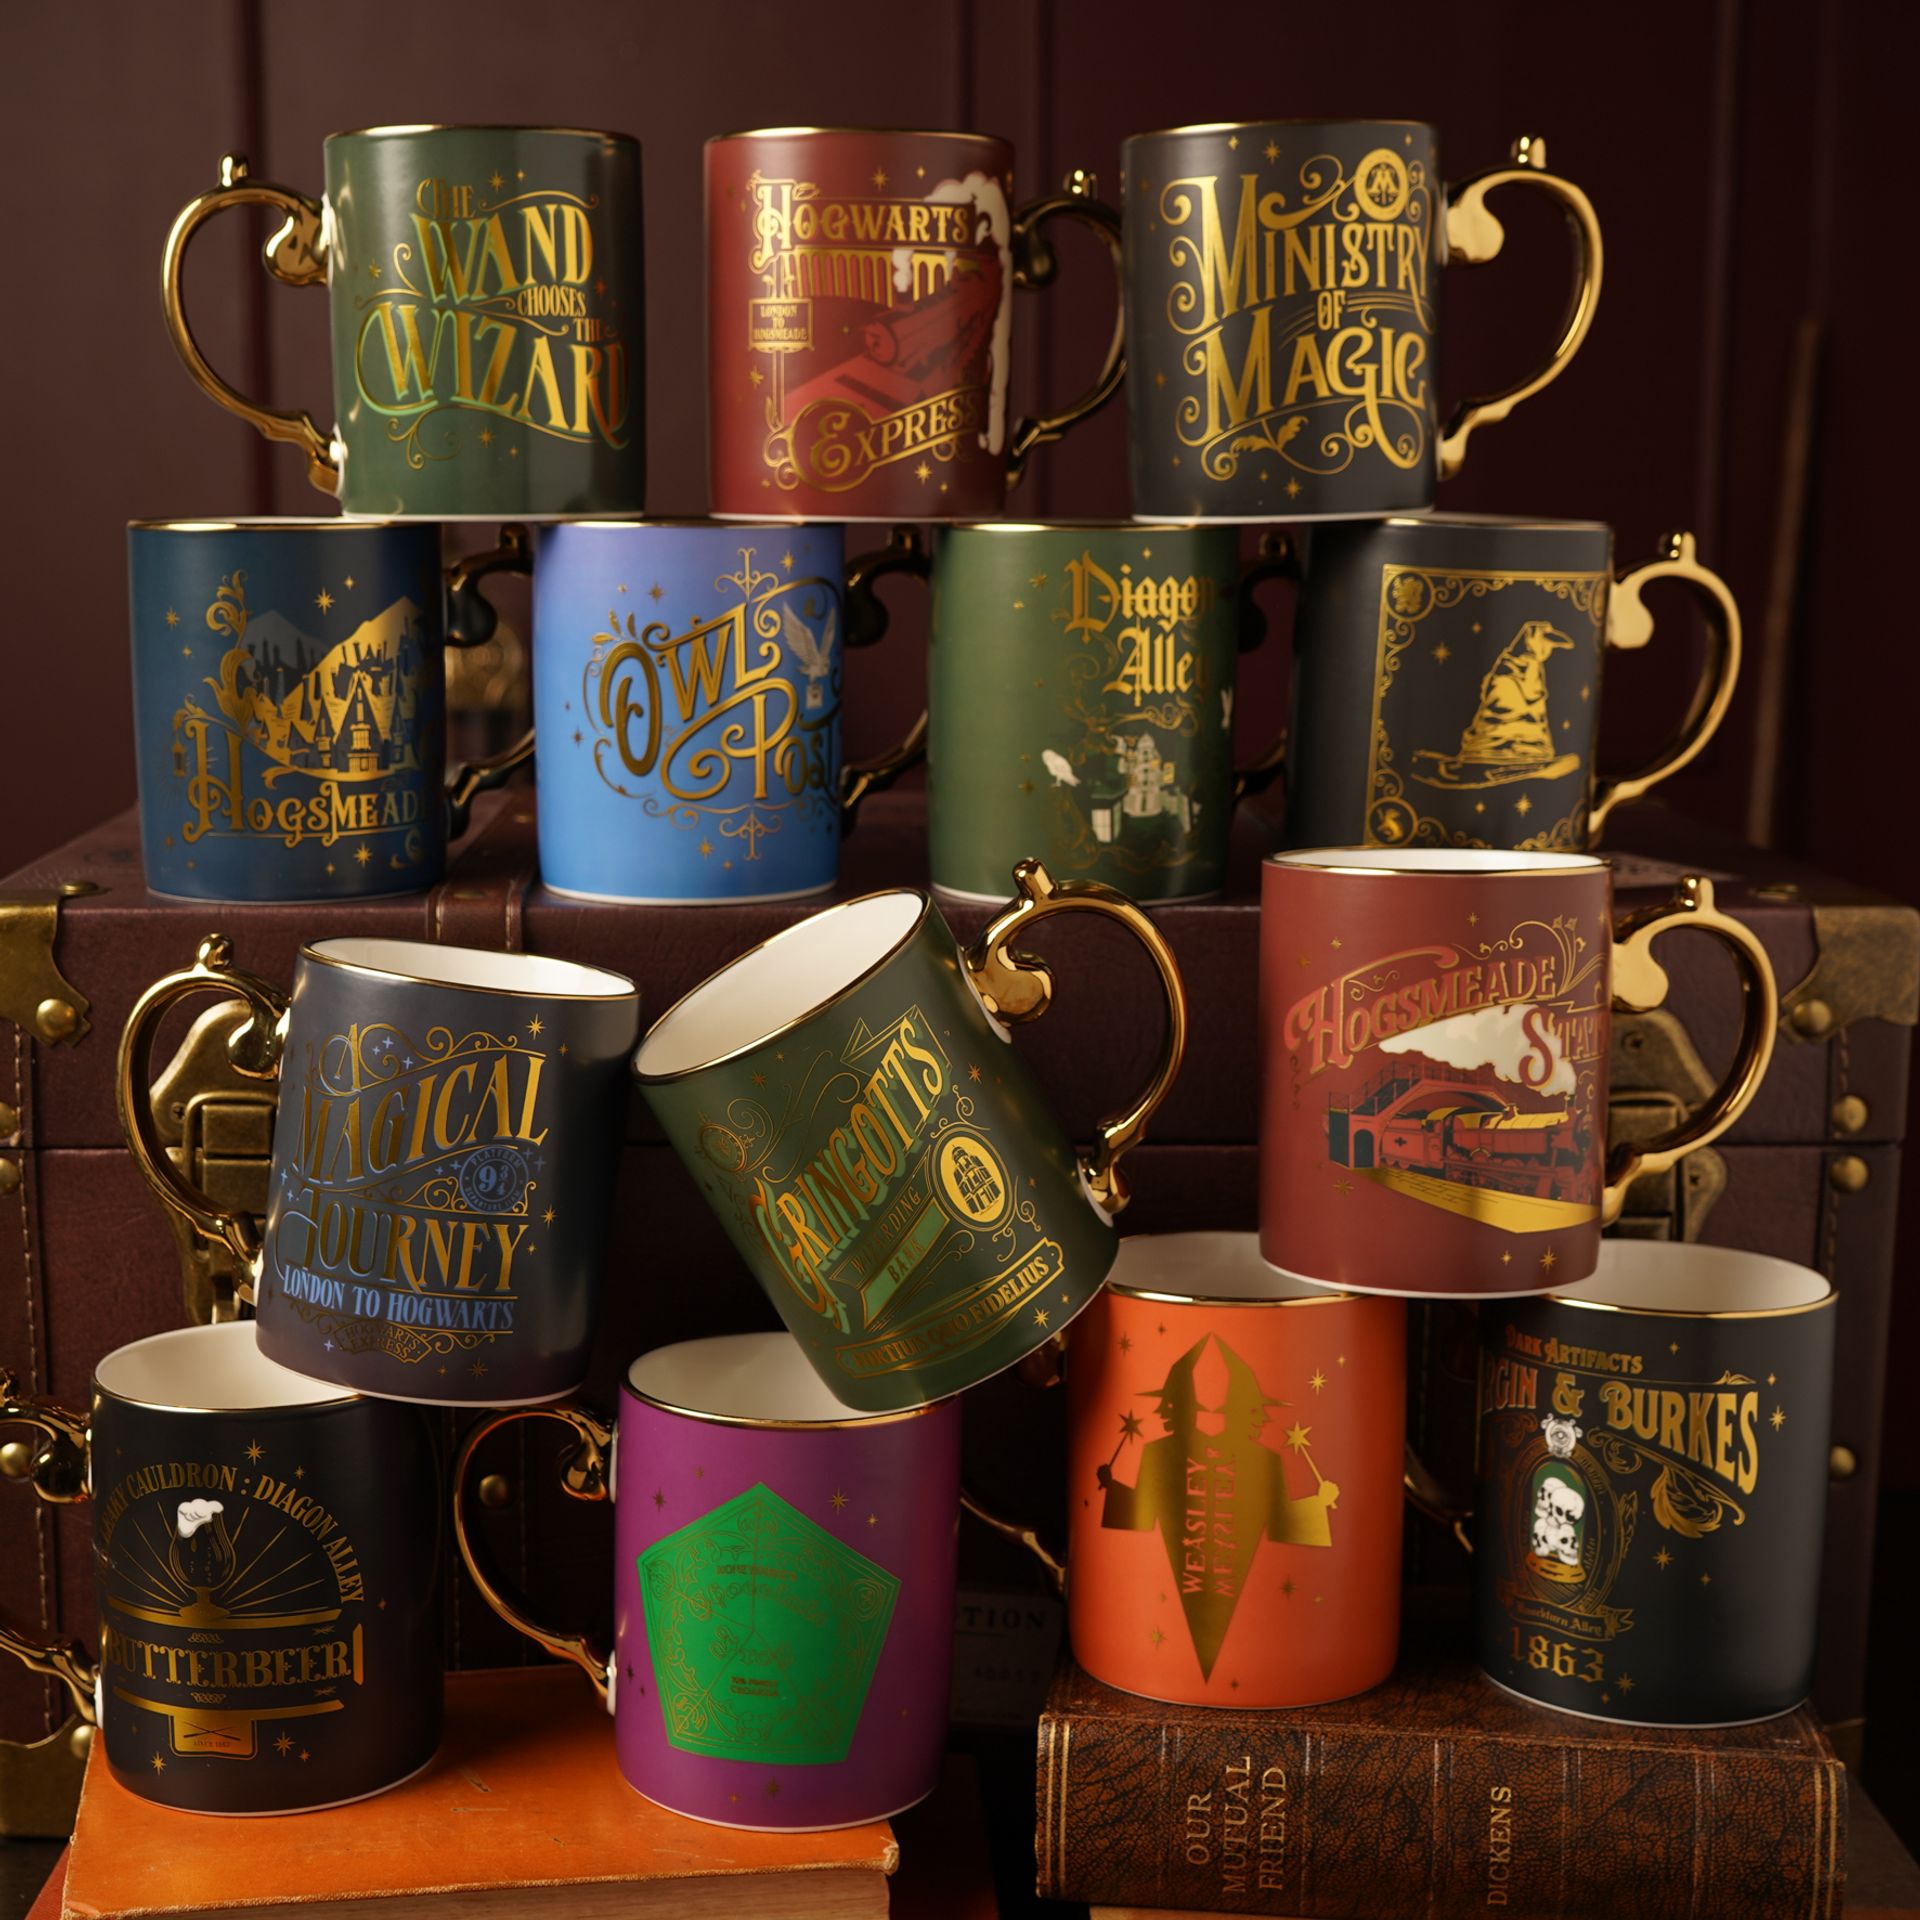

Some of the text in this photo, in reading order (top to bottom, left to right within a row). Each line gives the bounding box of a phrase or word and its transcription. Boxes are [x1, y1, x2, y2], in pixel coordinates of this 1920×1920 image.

[410, 203, 593, 306] WAND
[749, 170, 970, 273] HOGWARTS
[1160, 174, 1433, 335] MINISTRY
[517, 284, 587, 317] CHOOSES
[1316, 289, 1347, 331] OF
[354, 301, 631, 451] WIZARD
[809, 391, 979, 479] EXPRESS
[1173, 305, 1428, 469] MAGIC
[1283, 945, 1558, 1075] HOGSMEADE
[291, 1053, 549, 1184] MAGICAL
[750, 1016, 950, 1334] GRINGOTTS
[275, 1188, 529, 1294] JOURNEY
[283, 1264, 516, 1334] LONDON TO HOGWARTS
[966, 1254, 1051, 1324] FIDELIUS
[1543, 1336, 1644, 1376] ARTIFACTS
[1551, 1372, 1585, 1418] &
[1599, 1380, 1760, 1496] BURKES
[126, 1461, 238, 1500] CAULDRON
[253, 1474, 338, 1541] DIAGON
[322, 1535, 365, 1604] ALLEY
[1181, 1456, 1208, 1596] WEASLEY
[1185, 1790, 1213, 1865] OUR
[1221, 1754, 1251, 1894] MUTUAL
[1257, 1766, 1287, 1891] FRIEND
[1486, 1785, 1513, 1906] DICKENS
